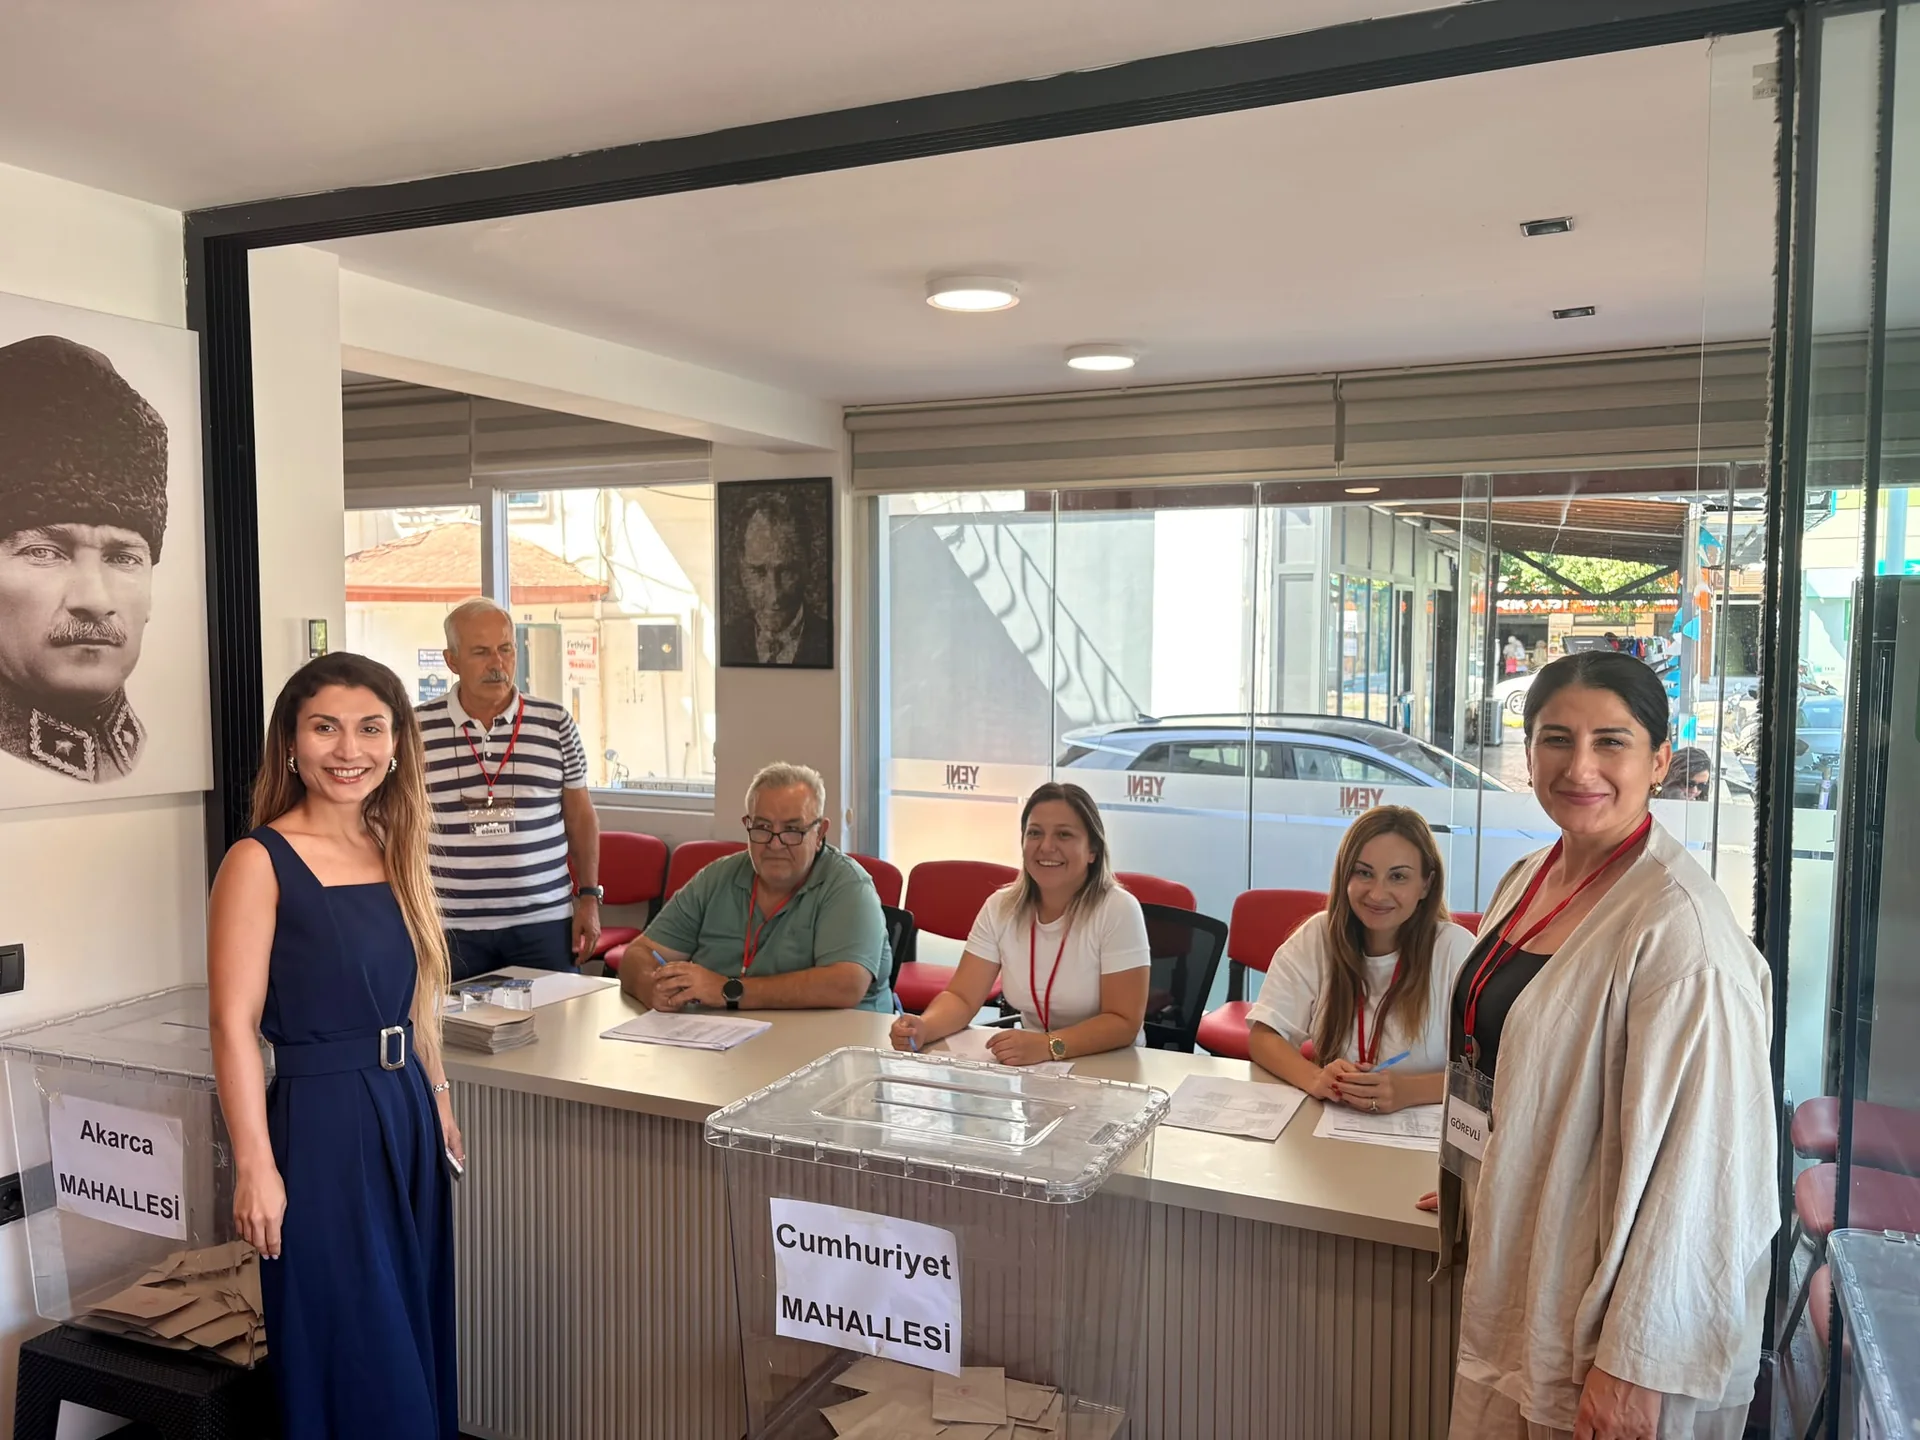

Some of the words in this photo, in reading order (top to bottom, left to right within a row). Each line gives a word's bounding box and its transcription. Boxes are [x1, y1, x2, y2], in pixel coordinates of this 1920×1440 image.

[80, 1119, 154, 1156] Akarca
[1450, 1116, 1481, 1142] GÖREVLİ
[59, 1172, 180, 1221] MAHALLESİ
[777, 1223, 952, 1280] Cumhuriyet
[782, 1294, 951, 1355] MAHALLESİ
